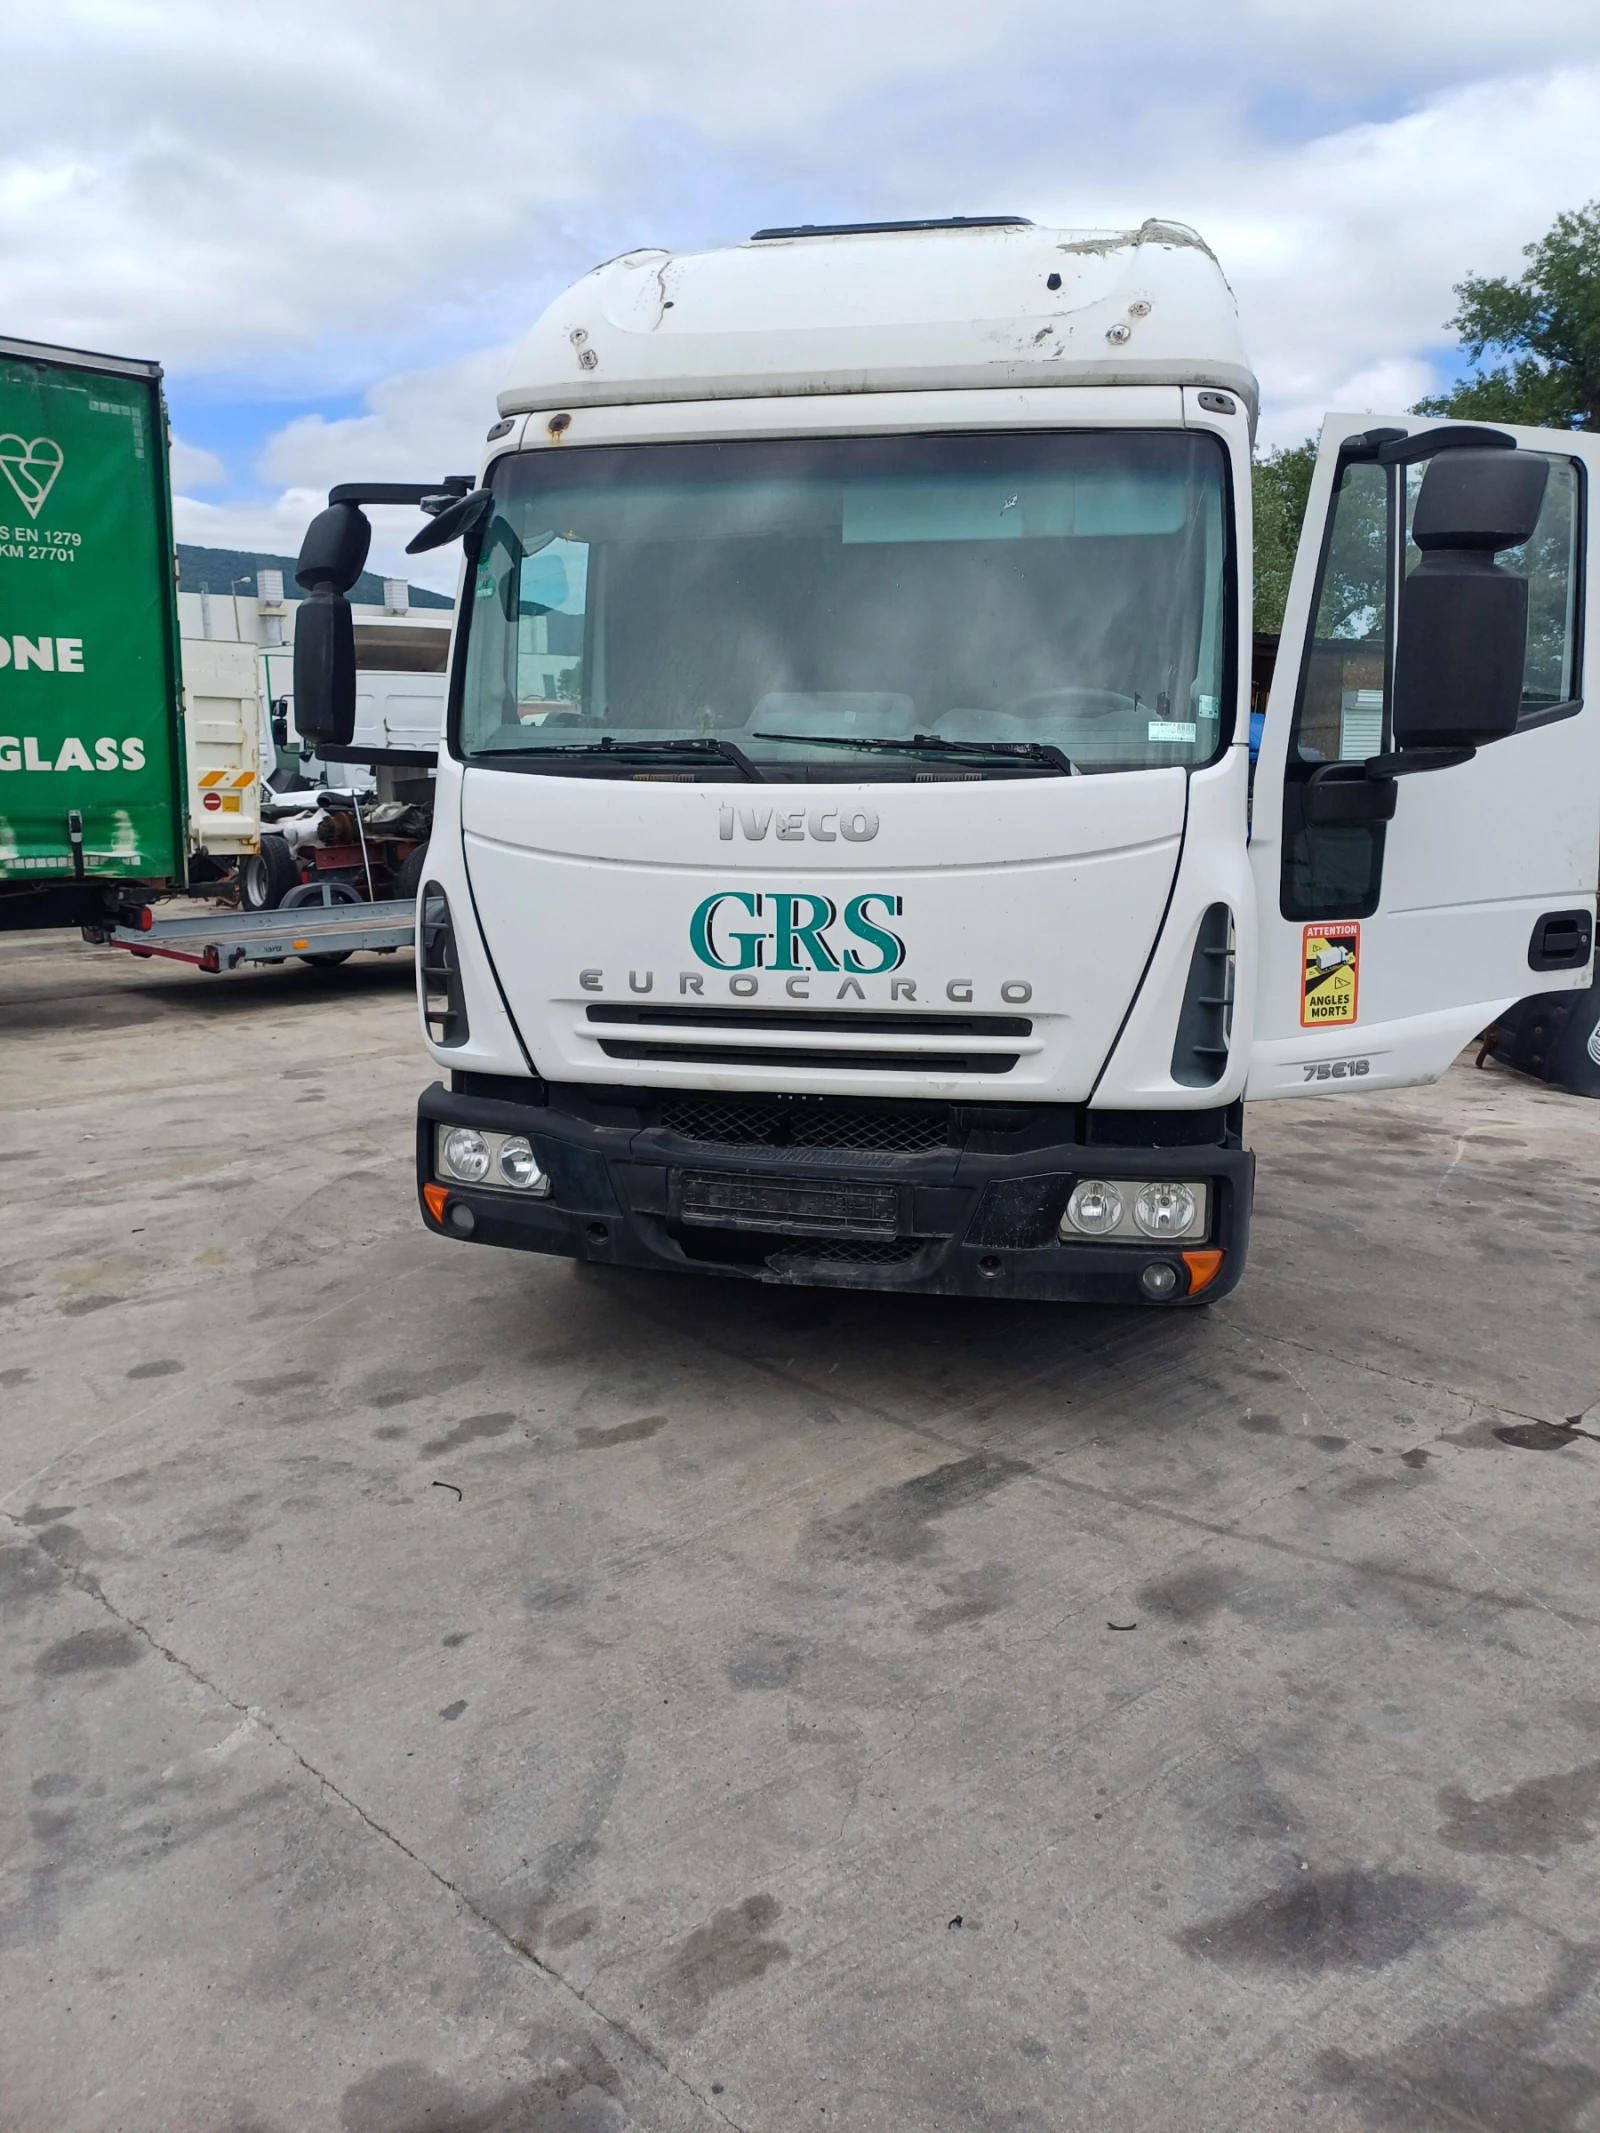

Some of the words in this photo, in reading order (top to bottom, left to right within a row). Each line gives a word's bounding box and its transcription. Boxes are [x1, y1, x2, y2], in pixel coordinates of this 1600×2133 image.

[14, 527, 39, 542] EN
[44, 531, 82, 546] 1279
[28, 546, 75, 562] 27701
[0, 736, 146, 771] GLASS
[719, 806, 880, 842] IVECO
[690, 892, 906, 974] GRS
[1307, 925, 1357, 937] ATTENTION
[579, 969, 1033, 1004] EUROCARGO
[1309, 994, 1350, 1006] ANGLES
[1311, 1006, 1348, 1018] MORTS
[1303, 1060, 1370, 1082] 75E18
